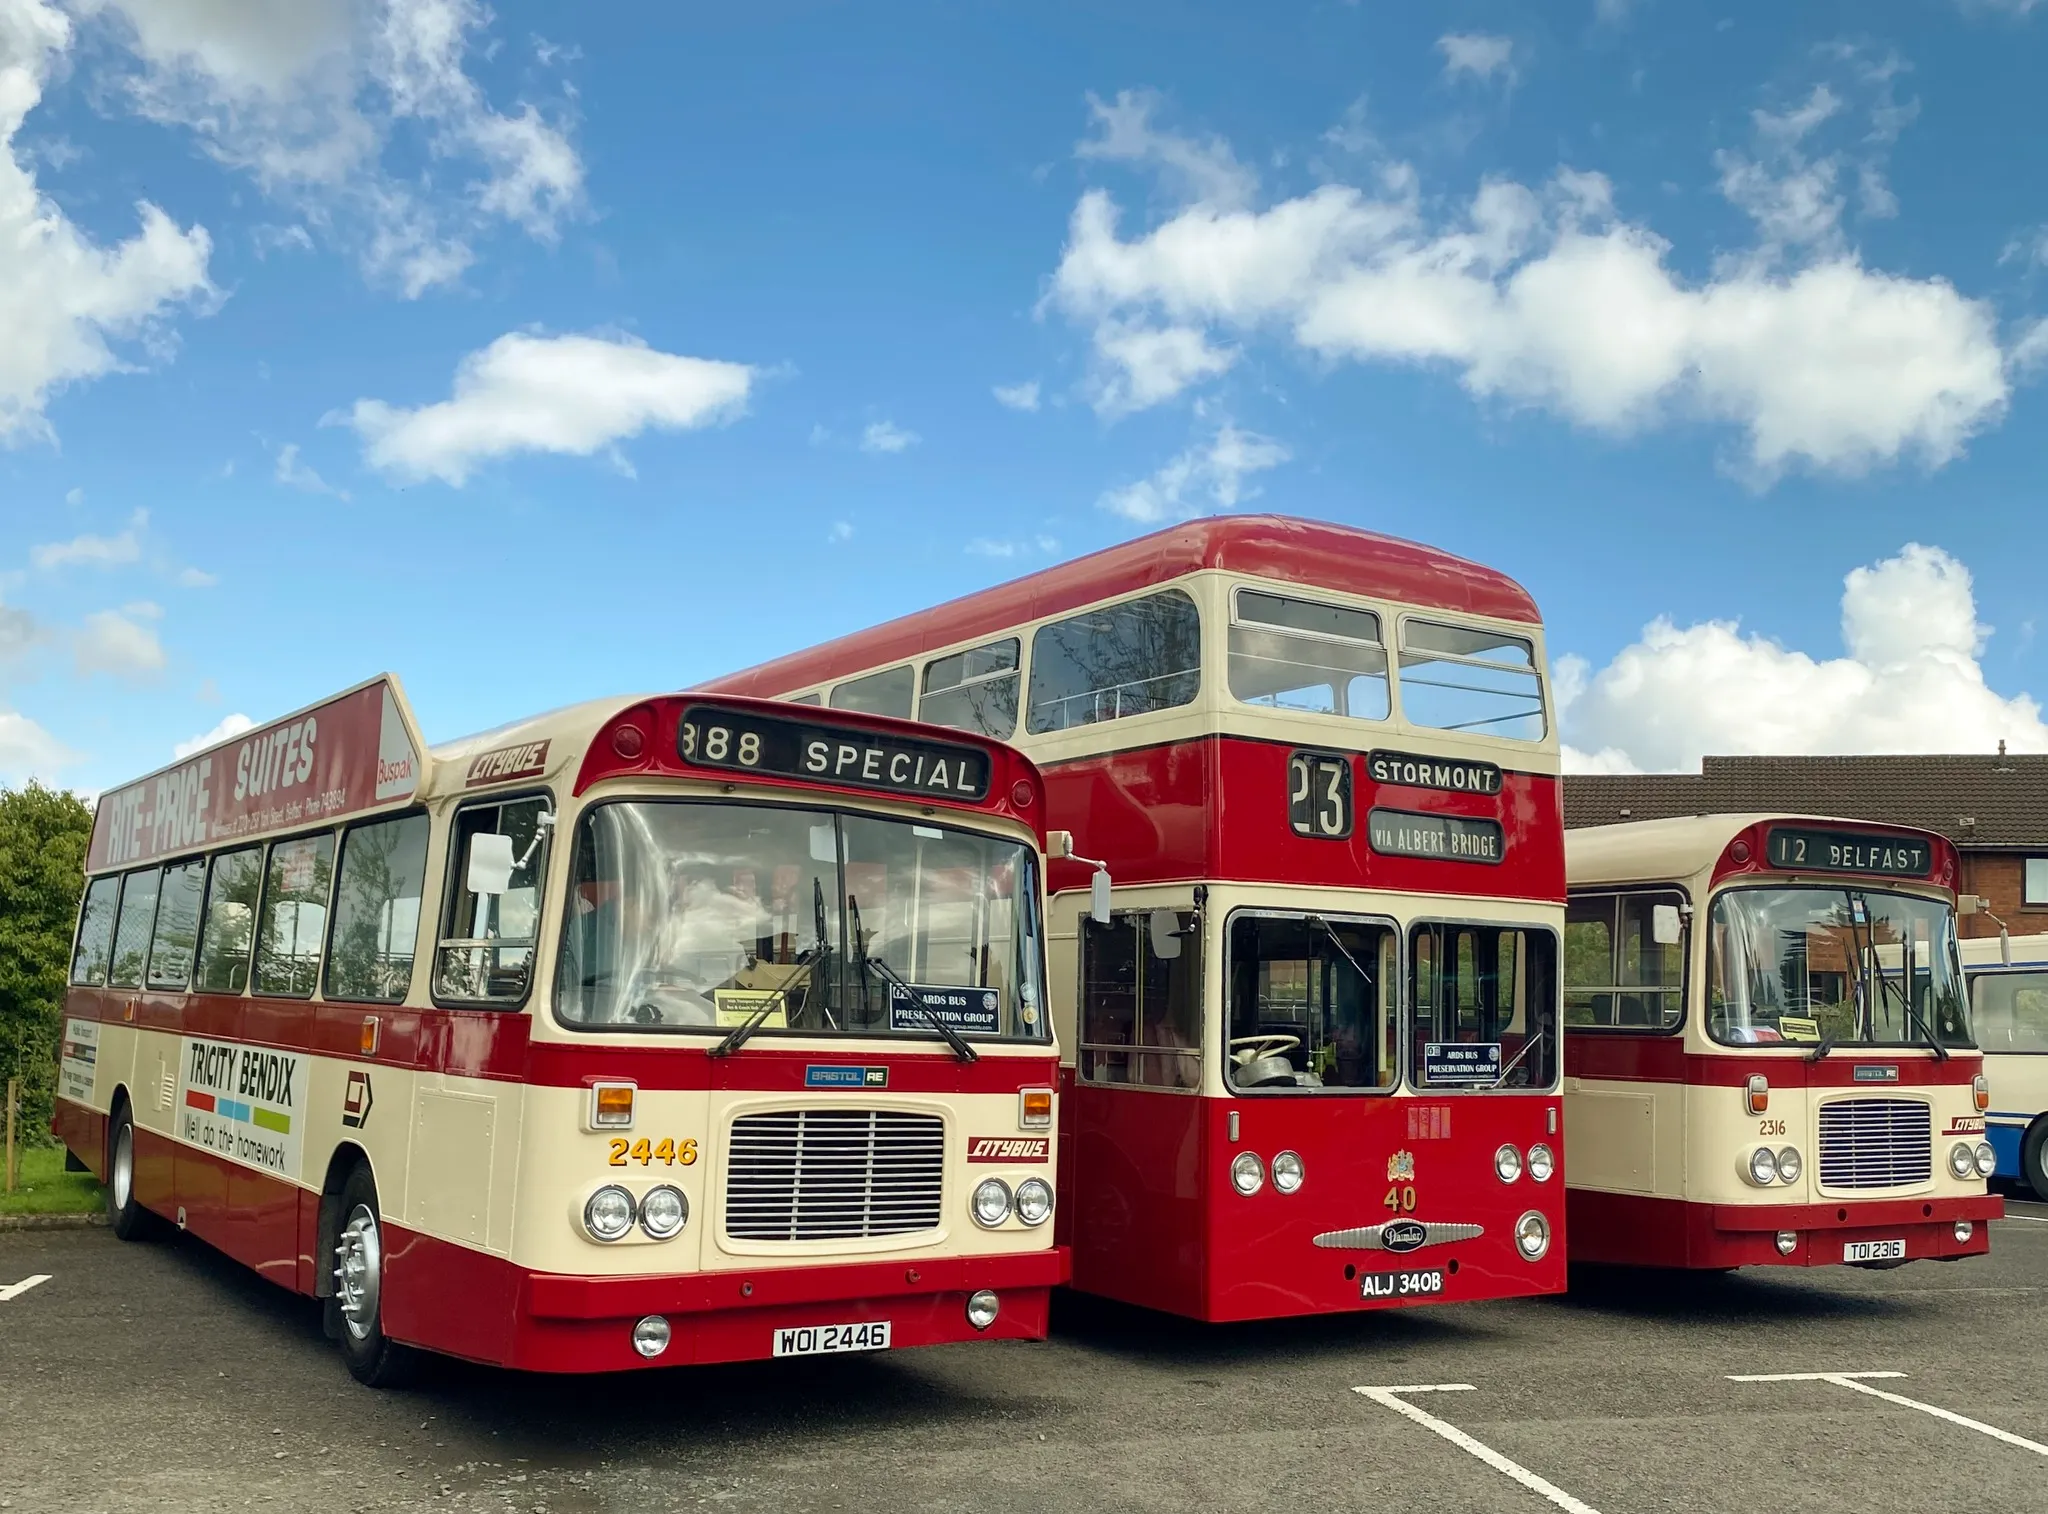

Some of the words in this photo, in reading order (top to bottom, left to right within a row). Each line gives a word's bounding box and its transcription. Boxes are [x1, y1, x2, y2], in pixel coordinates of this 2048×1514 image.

[234, 717, 317, 801] SUITES
[378, 751, 413, 786] Buspak
[469, 741, 547, 779] CITYBUS
[805, 741, 976, 792] SPECIAL
[1374, 760, 1496, 791] STORMONT
[1292, 758, 1344, 835] 23
[1375, 829, 1393, 847] VIA
[1397, 828, 1444, 853] ALBERT
[1451, 832, 1496, 857] BRIDGE
[1781, 837, 1806, 862] 12
[1830, 845, 1922, 869] BELFAST
[922, 994, 946, 1005] ARDS
[948, 996, 967, 1006] BUS
[895, 1009, 961, 1022] PRESEATION
[964, 1011, 994, 1023] GROUP
[1428, 1064, 1474, 1073] PRESERVATION
[1475, 1064, 1497, 1073] GROUP
[1447, 1051, 1464, 1060] ARDS
[1465, 1051, 1478, 1060] BUS
[190, 1042, 238, 1091] TRICITY
[239, 1050, 296, 1107] BENDIX
[811, 1071, 861, 1081] BRISTOL
[1760, 1120, 1786, 1135] 2316
[203, 1120, 215, 1146] do
[218, 1123, 233, 1152] the
[236, 1129, 286, 1171] homework
[608, 1137, 698, 1166] 2446
[972, 1139, 1047, 1157] CITYBUS
[1384, 1186, 1416, 1212] 40
[1385, 1226, 1423, 1246] Daimler
[1851, 1243, 1870, 1259] TOI
[1873, 1241, 1900, 1258] 2316
[1362, 1274, 1394, 1296] ALJ
[1399, 1271, 1441, 1294] 340B
[782, 1329, 817, 1353] WOI
[823, 1324, 885, 1350] 2446
